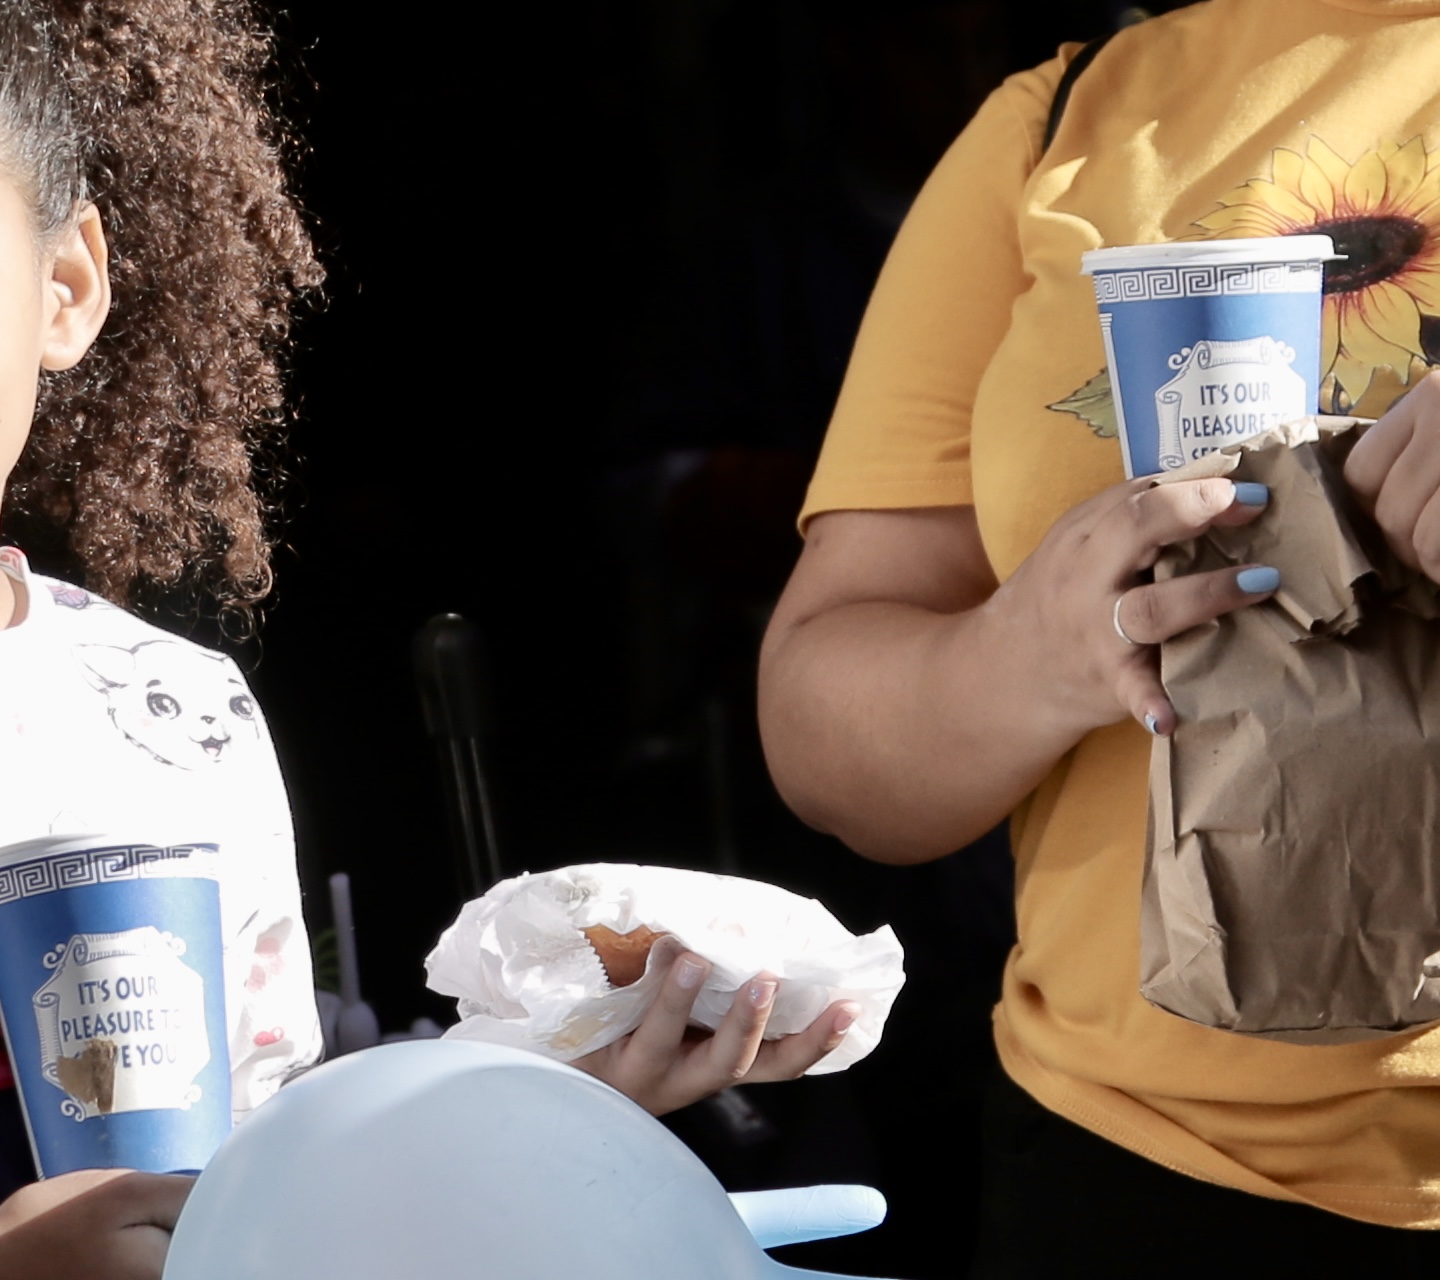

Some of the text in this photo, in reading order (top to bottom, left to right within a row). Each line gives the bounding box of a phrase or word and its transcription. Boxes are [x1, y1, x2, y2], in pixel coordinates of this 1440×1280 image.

[1199, 382, 1271, 406] IT'S OUR
[1182, 413, 1266, 438] PLEASURE
[78, 976, 158, 1005] IT'S OUR
[61, 1009, 155, 1042] PLEASURE
[136, 1043, 177, 1067] YOU
